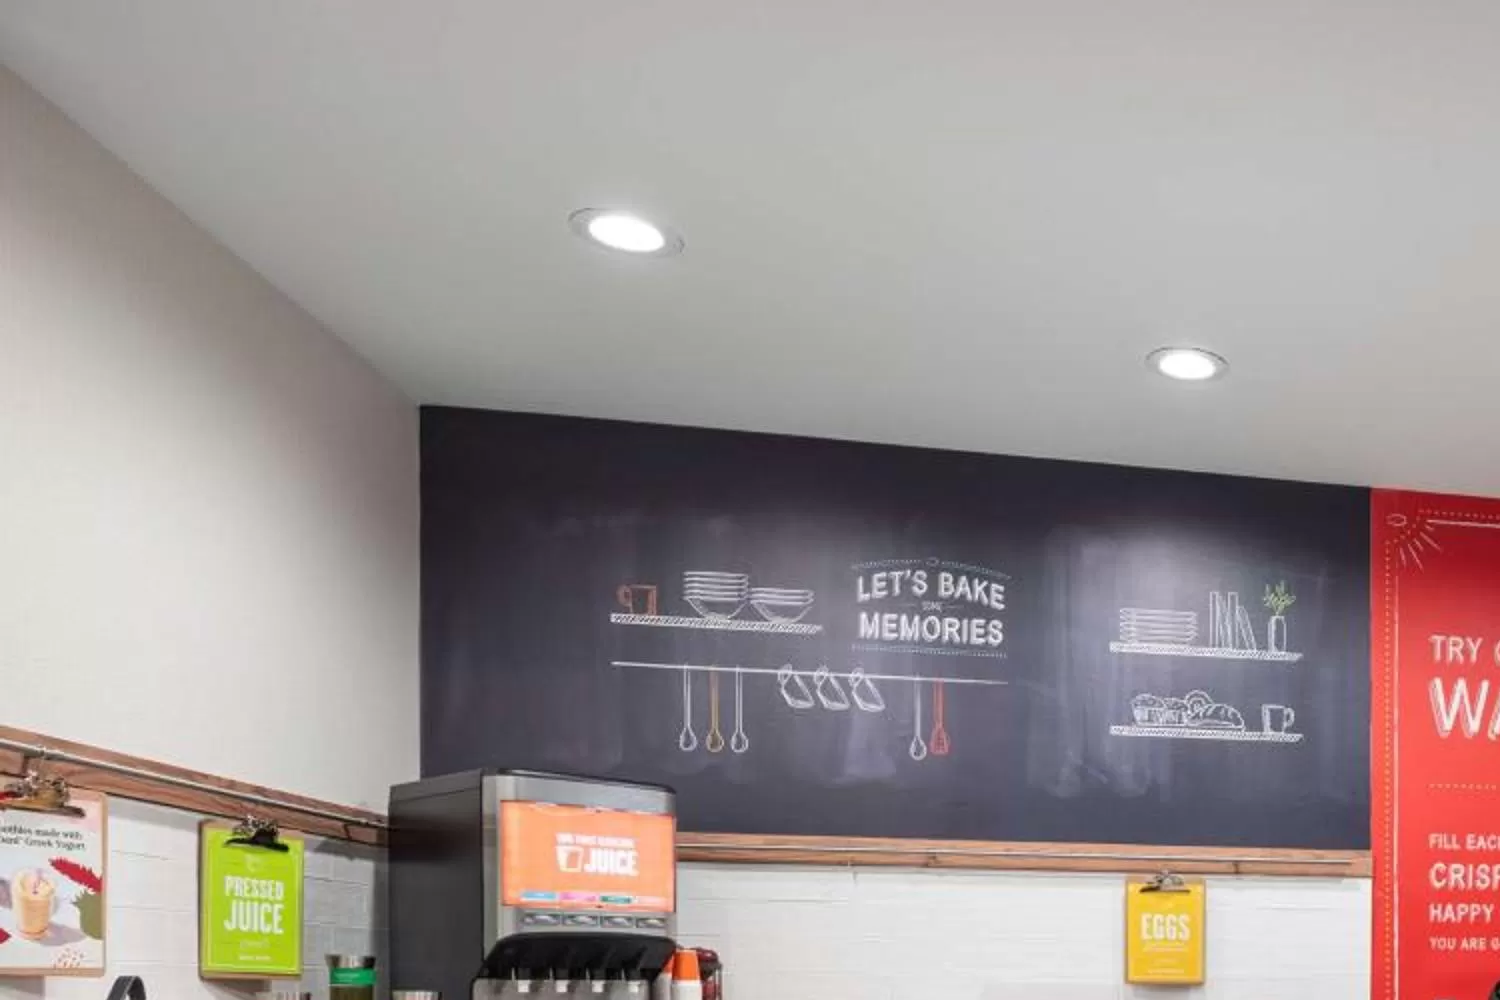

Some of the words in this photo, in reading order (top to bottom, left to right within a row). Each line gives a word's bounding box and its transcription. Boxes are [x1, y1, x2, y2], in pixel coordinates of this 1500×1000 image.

[857, 569, 929, 603] LET'S
[937, 571, 1005, 611] BAKE
[859, 611, 1004, 648] MEMORIES
[1429, 634, 1484, 665] TRY
[1428, 833, 1461, 850] FILL
[583, 848, 639, 876] JUICE
[224, 876, 285, 901] PRESSED
[223, 899, 285, 934] JUICE
[1141, 913, 1191, 941] EGGS
[1428, 902, 1494, 924] HAPPY
[1429, 937, 1456, 951] YOU
[1461, 938, 1486, 951] ARE
